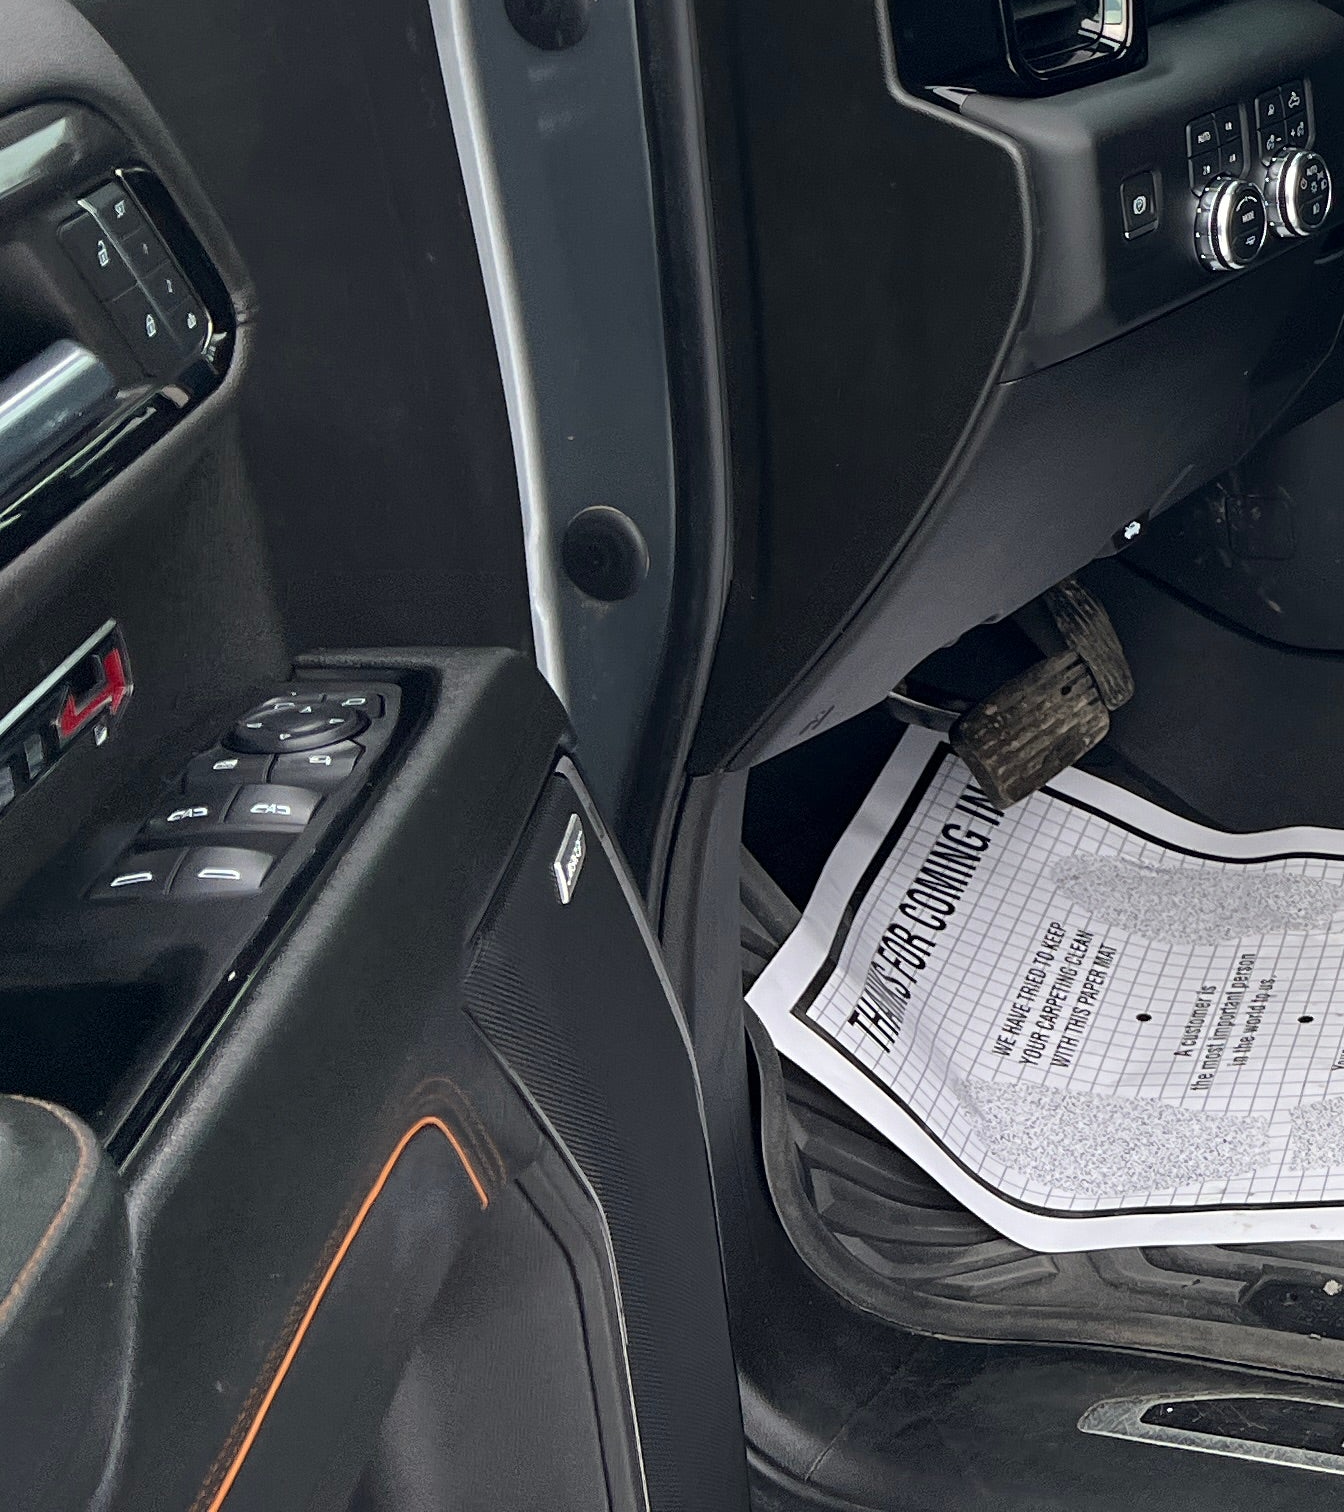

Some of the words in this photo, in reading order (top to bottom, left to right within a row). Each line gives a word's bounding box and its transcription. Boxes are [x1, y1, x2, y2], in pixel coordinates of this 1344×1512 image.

[899, 823, 991, 931] COMING
[1040, 921, 1066, 951] KEEP
[877, 923, 936, 984] FOR
[1033, 950, 1055, 967] TO
[1093, 942, 1117, 969] MAT
[1016, 967, 1046, 1002] TRIED
[1231, 953, 1256, 988] person
[1018, 1031, 1050, 1066] YOUR
[1035, 966, 1078, 1031] CARPETING
[1064, 929, 1094, 966] CLEAN
[1077, 968, 1107, 1007] PAPER
[1195, 985, 1217, 995] is
[1250, 992, 1271, 1003] to
[847, 961, 911, 1053] THANKS
[1001, 1002, 1031, 1036] HAVE
[1064, 1007, 1091, 1034] THIS
[1181, 996, 1212, 1047] customer
[1208, 991, 1245, 1040] important
[1242, 1004, 1266, 1034] world
[992, 1034, 1017, 1057] WE
[1050, 1034, 1080, 1068] WITH
[1173, 1048, 1193, 1057] A
[1201, 1043, 1225, 1070] most
[1232, 1035, 1255, 1053] the
[1227, 1055, 1249, 1067] in
[1190, 1073, 1214, 1091] the
